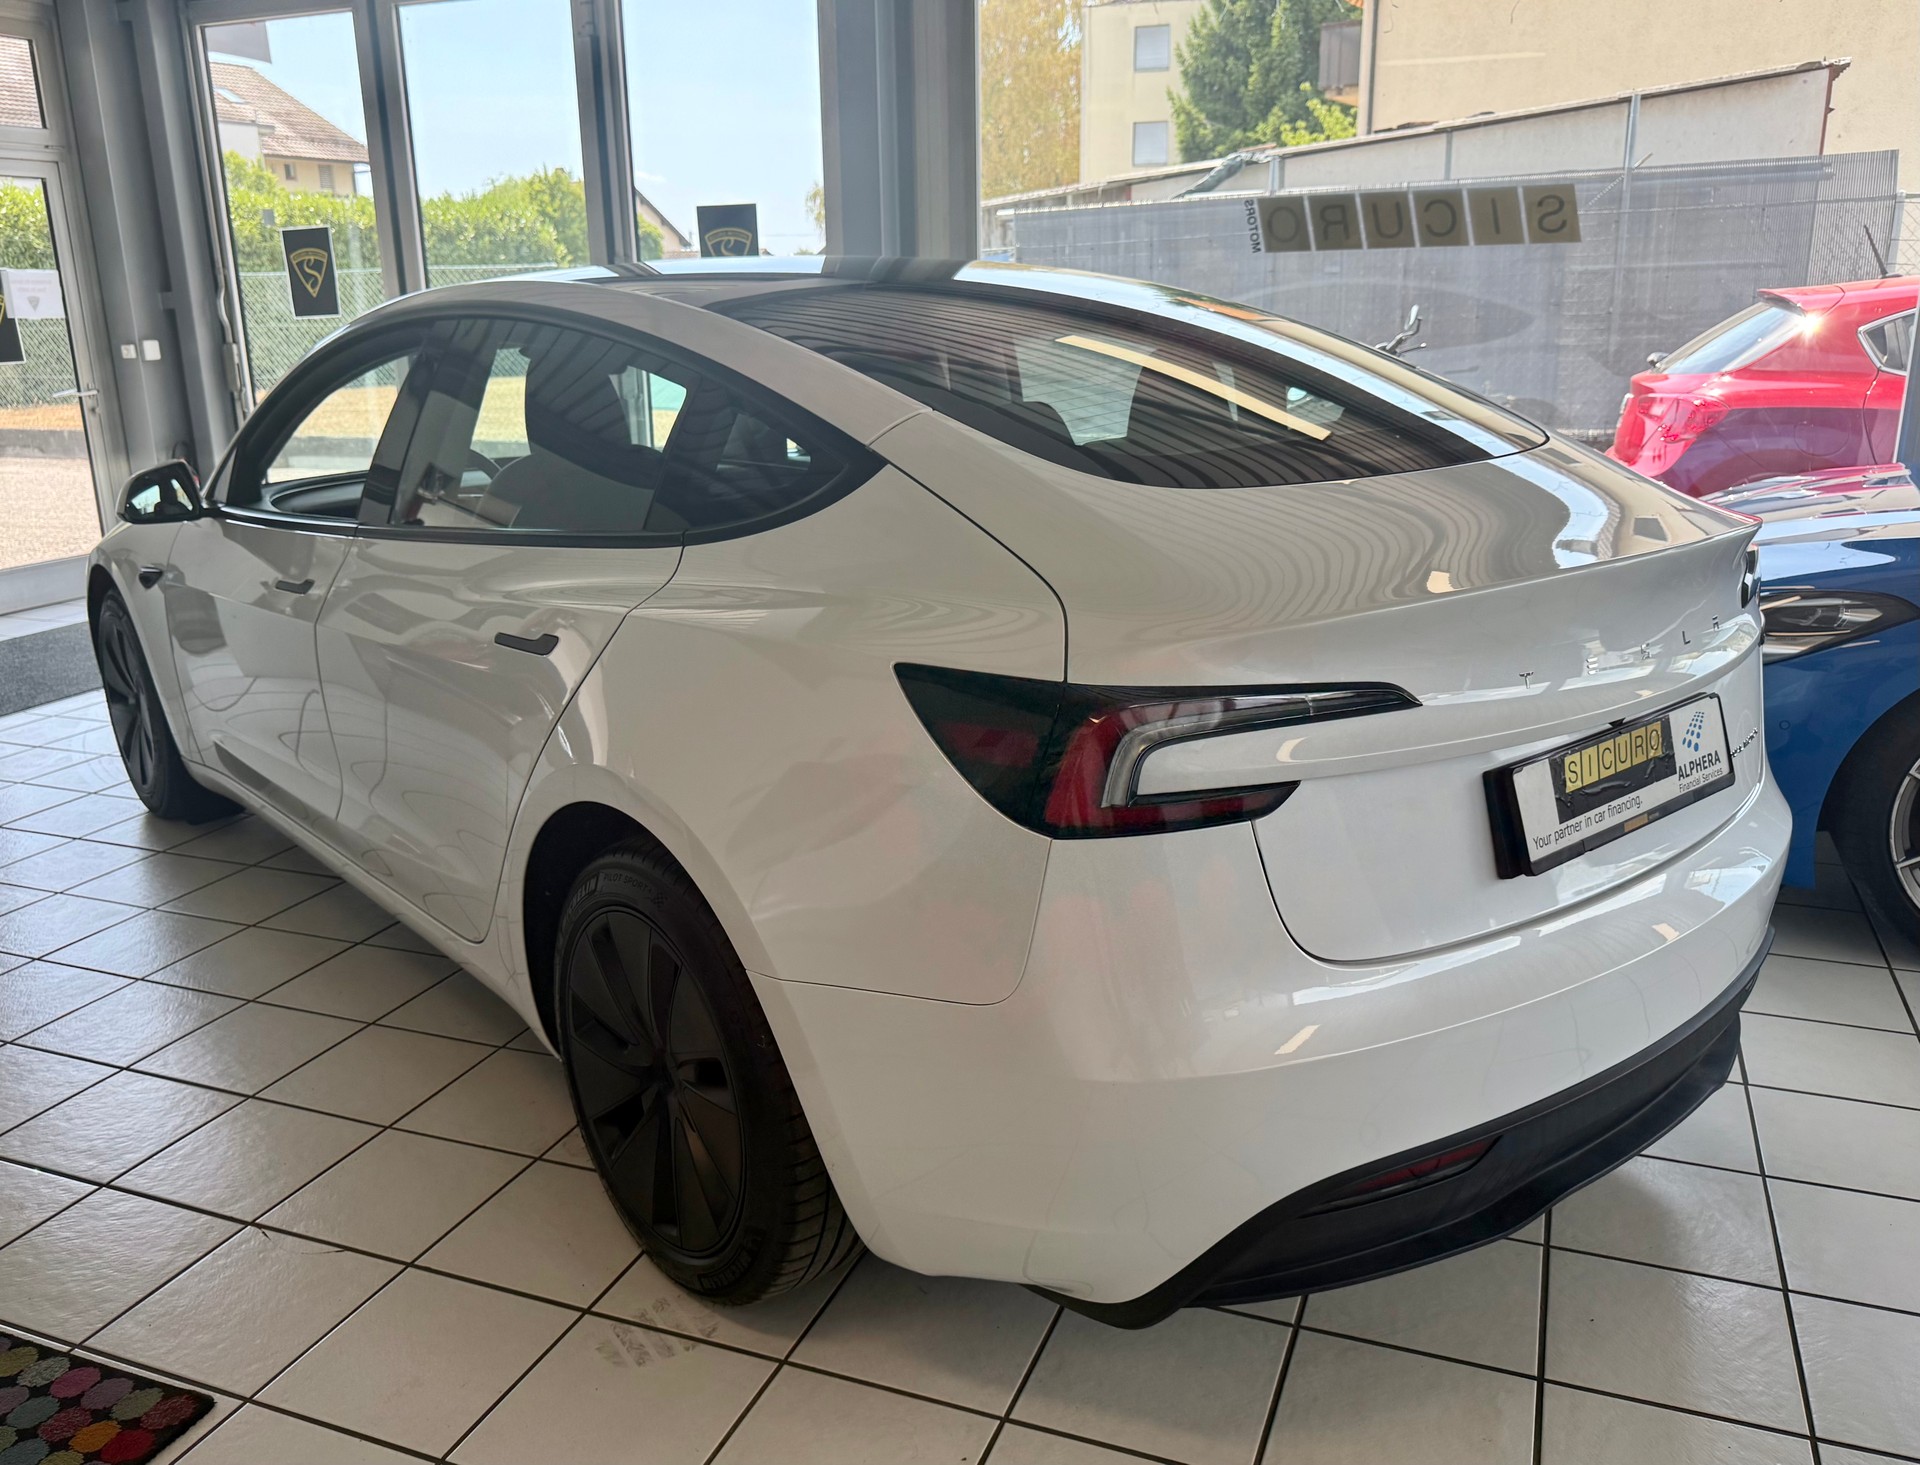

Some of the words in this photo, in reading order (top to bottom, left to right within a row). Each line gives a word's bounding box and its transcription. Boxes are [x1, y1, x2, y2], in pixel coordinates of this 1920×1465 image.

[1568, 727, 1661, 784] SICURO
[1678, 749, 1721, 782] ALPHERA
[1679, 776, 1701, 793] Financial
[1702, 767, 1723, 783] Services
[1532, 832, 1552, 851] Your
[1554, 819, 1583, 845] partner
[1584, 815, 1593, 828] in
[1594, 809, 1606, 825] car
[1607, 795, 1643, 818] financing.
